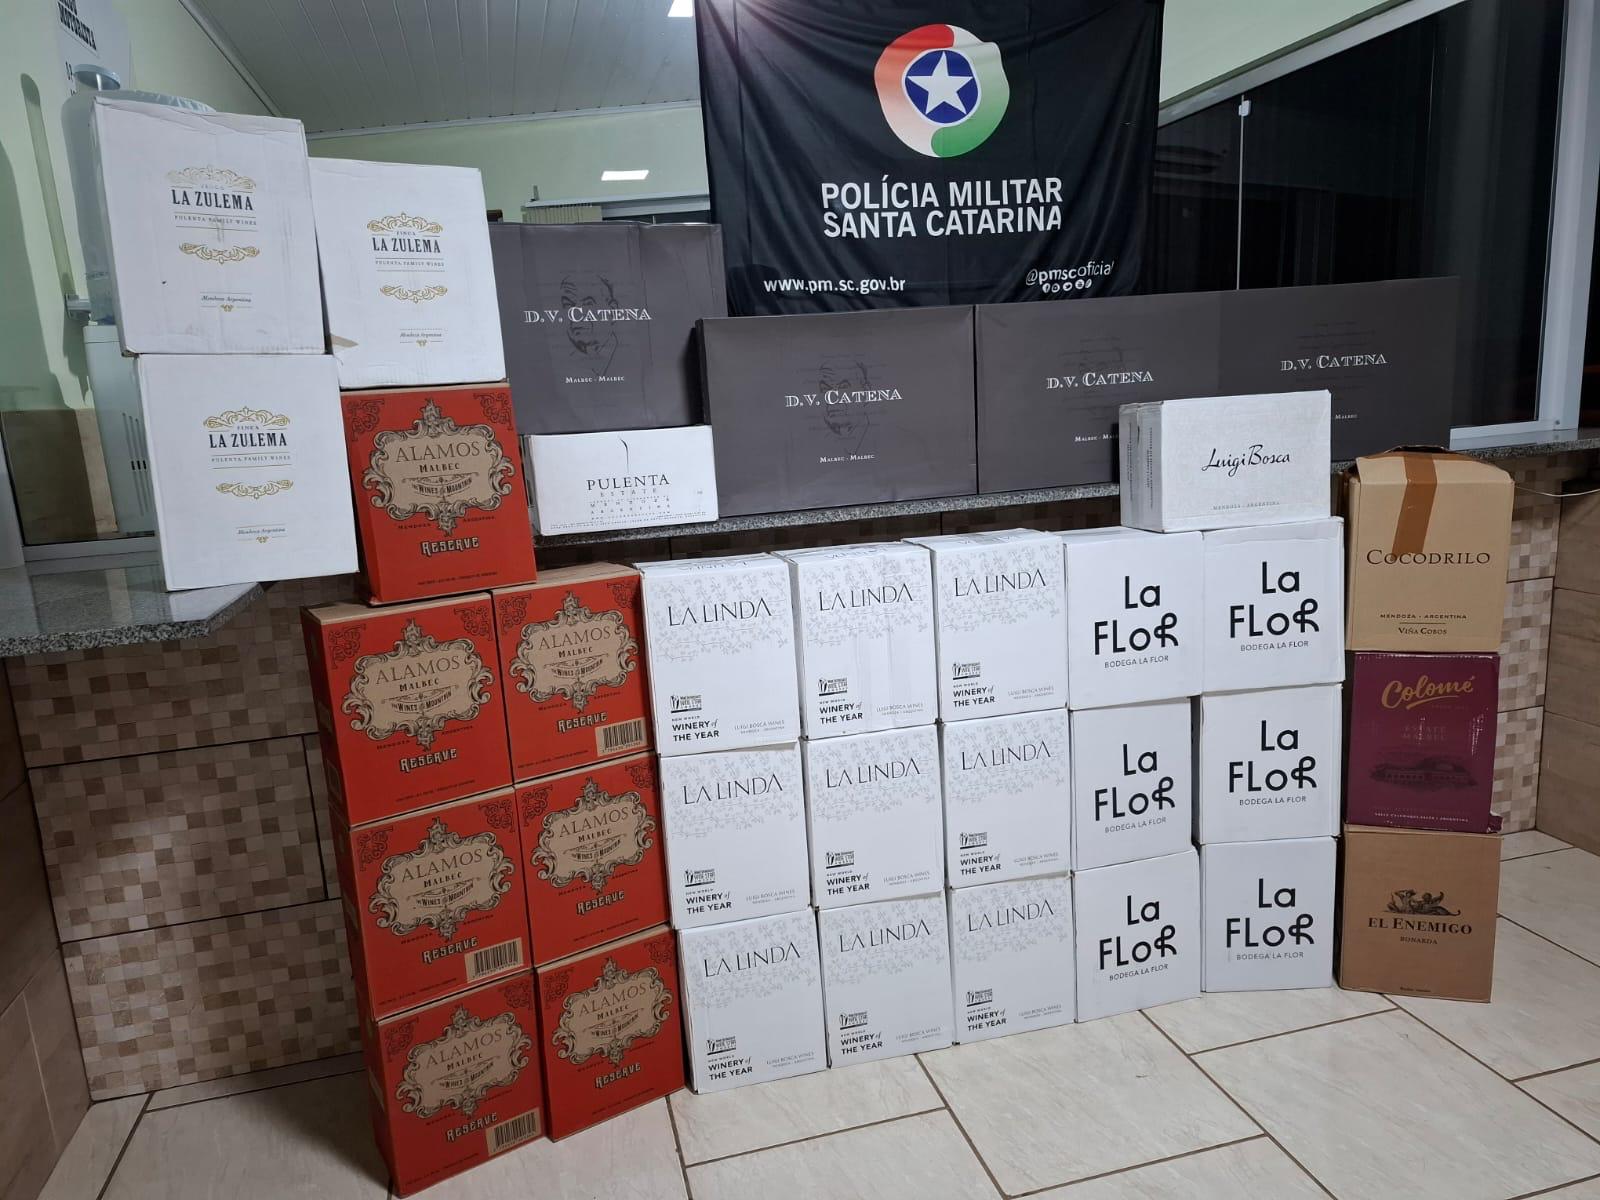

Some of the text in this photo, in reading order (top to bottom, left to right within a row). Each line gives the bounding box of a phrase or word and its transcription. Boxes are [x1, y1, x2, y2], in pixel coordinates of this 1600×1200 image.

[171, 189, 253, 210] LA ZULEMA
[821, 175, 1063, 209] POLÍCIA MILITAR
[823, 205, 1062, 238] SANTA CATARINA
[372, 237, 441, 253] LA ZULEMA
[1025, 259, 1115, 286] @pmscoficial
[763, 276, 906, 294] www.pm.sc.gov.br
[523, 307, 652, 323] D.V. CATENA
[1280, 353, 1387, 371] D.V. CATENA
[1046, 370, 1154, 389] D.V. CATENA
[784, 388, 902, 407] D.V. CATENA
[209, 433, 287, 448] LA ZULEMA
[395, 441, 480, 463] ALAMOS
[1201, 444, 1290, 477] Luigi Bosca
[419, 462, 460, 473] MALBEC
[586, 474, 670, 490] PULENTA
[1366, 549, 1491, 565] COCODRILO
[955, 568, 1046, 597] LA LINDA
[1262, 561, 1299, 594] La
[818, 583, 913, 611] LA LINDA
[1124, 575, 1160, 609] La
[668, 597, 772, 626] LA LINDA
[538, 626, 611, 650] ALAMOS
[1240, 640, 1309, 651] BODEGA LA FLOR
[375, 655, 461, 685] ALAMOS
[1104, 655, 1169, 668] BODEGA LA FLOR
[953, 686, 987, 697] WINERY
[1381, 674, 1475, 709] Colomé
[819, 703, 854, 714] WINERY
[953, 696, 995, 708] THE YEAR
[672, 720, 710, 731] WINERY
[820, 713, 863, 725] THE YEAR
[673, 730, 720, 742] THE YEAR
[1261, 719, 1298, 751] La
[962, 740, 1051, 770] LA LINDA
[1122, 743, 1158, 776] La
[826, 757, 921, 788] LA LINDA
[683, 773, 783, 805] LA LINDA
[1239, 795, 1307, 806] BODEGA LA FLOR
[559, 806, 630, 838] ALAMOS
[1104, 816, 1167, 833] BODEGA LA FLOR
[401, 848, 483, 883] ALAMOS
[960, 855, 994, 866] WINERY
[960, 863, 1001, 876] THE YEAR
[826, 874, 862, 886] WINERY
[686, 892, 723, 904] WINERY
[827, 883, 870, 896] THE YEAR
[1258, 878, 1296, 908] La
[686, 902, 732, 915] THE YEAR
[968, 899, 1054, 932] LA LINDA
[1127, 895, 1160, 925] La
[1368, 917, 1472, 935] EL ENEMIGO
[840, 919, 931, 953] LA LINDA
[1400, 936, 1438, 944] BONARDA
[704, 942, 800, 977] LA LINDA
[1236, 952, 1270, 960] BODEGA
[1284, 951, 1304, 959] FLOR
[1109, 963, 1169, 981] BODEGA LA FLOR
[579, 982, 647, 1018] ALAMOS
[967, 1010, 999, 1022] WINERY
[967, 1018, 1007, 1032] THE YEAR
[426, 1028, 504, 1070] ALAMOS
[840, 1034, 875, 1046] WINERY
[841, 1041, 883, 1055] THE YEAR
[708, 1058, 744, 1071] WINERY
[709, 1066, 753, 1081] THE YEAR
